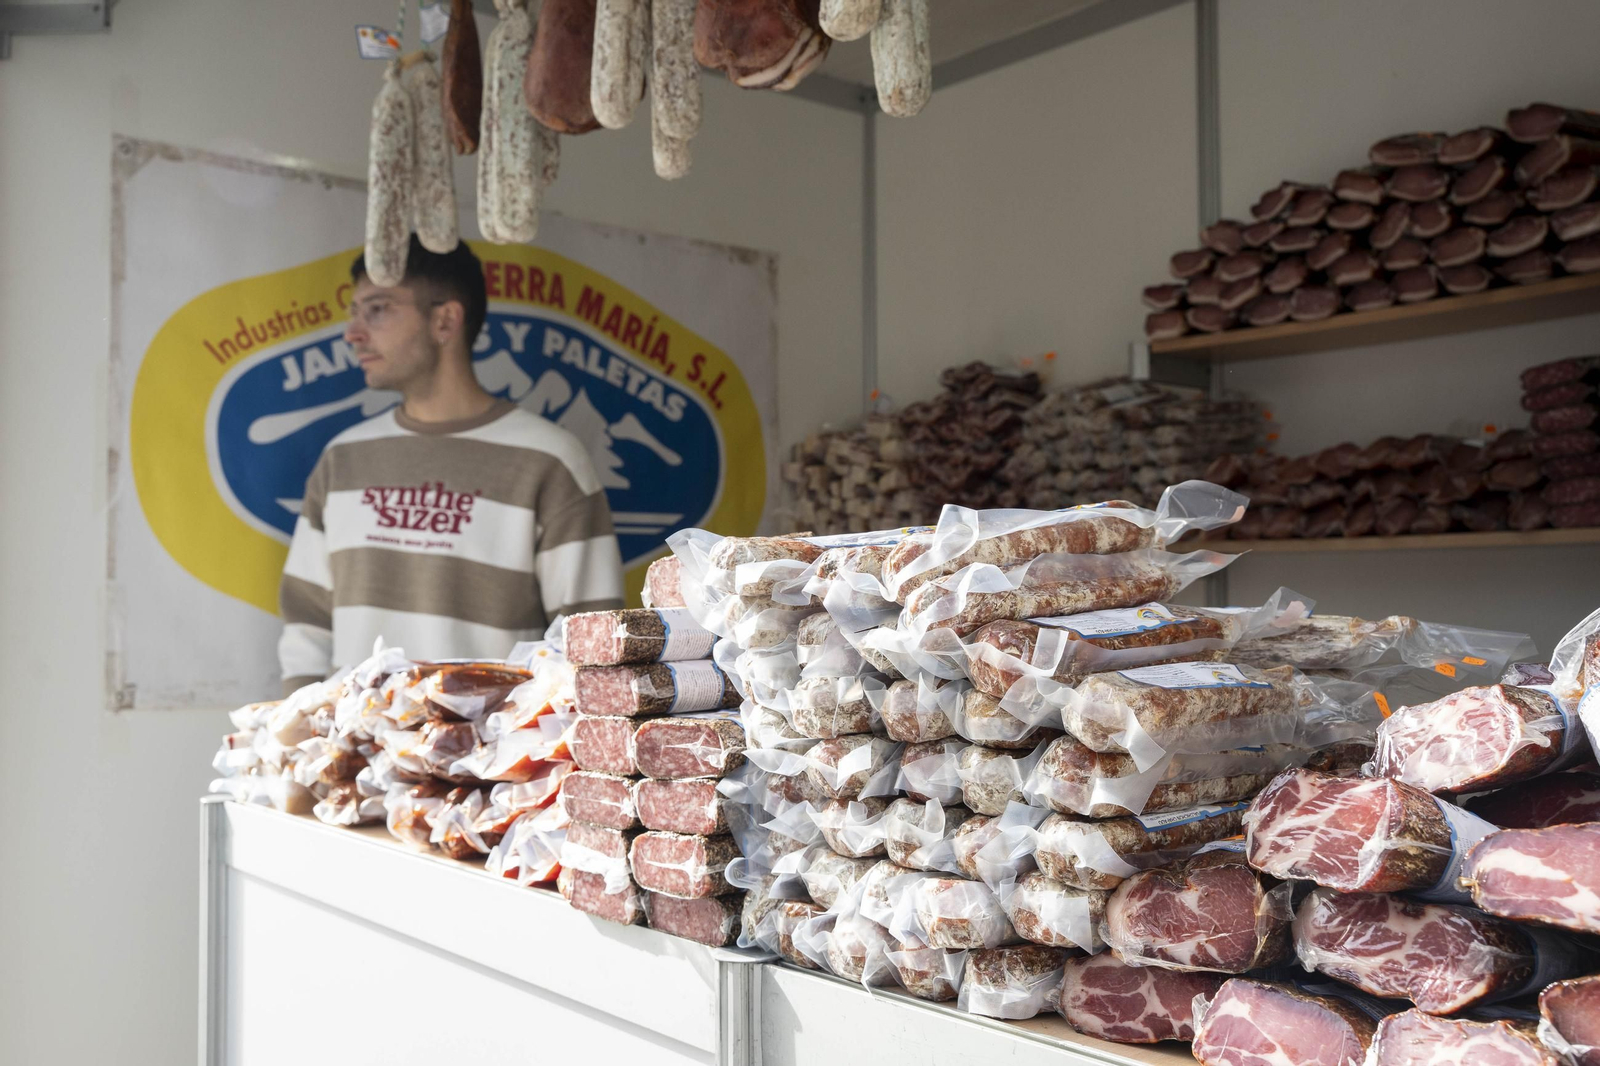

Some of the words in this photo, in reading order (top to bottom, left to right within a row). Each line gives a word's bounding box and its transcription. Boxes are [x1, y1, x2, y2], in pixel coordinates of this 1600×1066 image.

[203, 300, 333, 365] Industrias
[483, 260, 566, 309] ERRA
[575, 283, 677, 376] MARÍA,
[501, 322, 532, 354] Y
[543, 327, 688, 423] PALETAS
[361, 481, 474, 513] synthe
